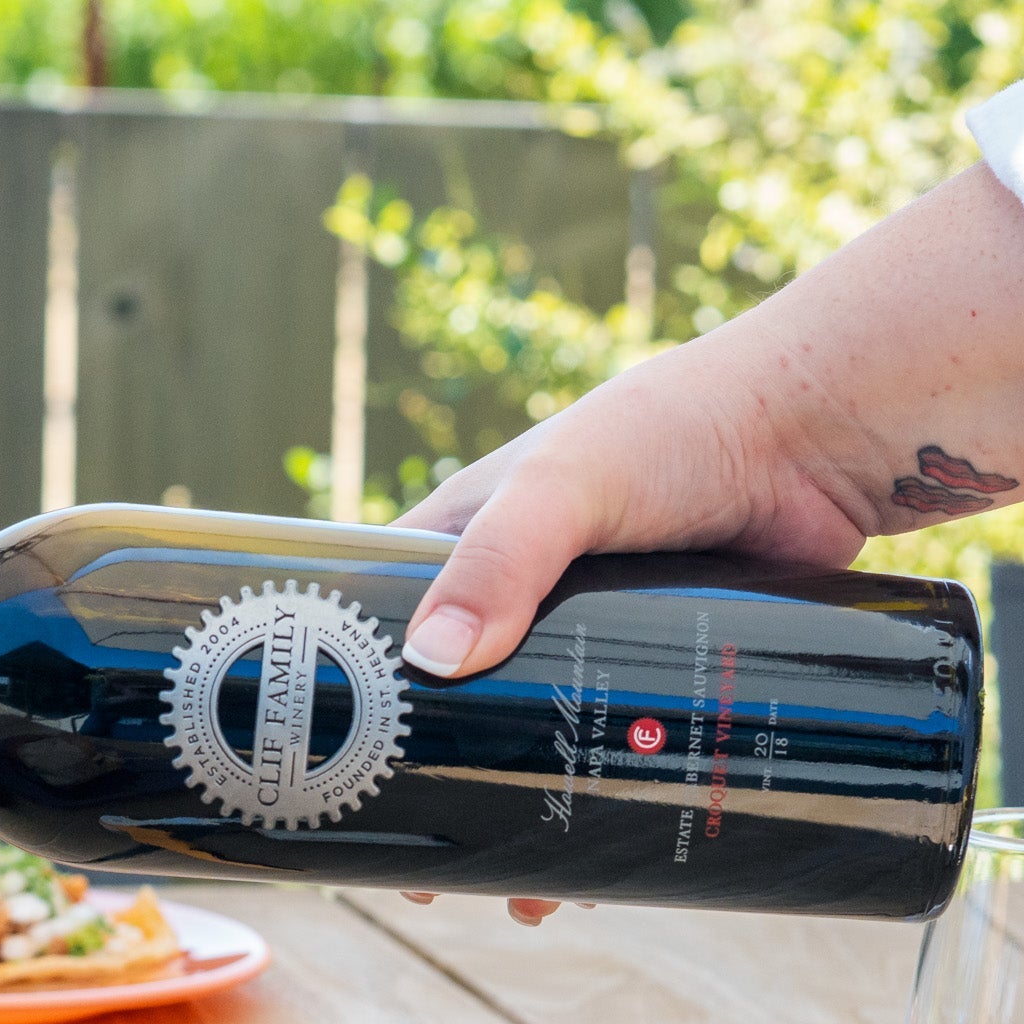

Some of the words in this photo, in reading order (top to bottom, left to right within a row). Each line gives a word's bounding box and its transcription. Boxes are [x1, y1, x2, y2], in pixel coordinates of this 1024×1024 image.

[200, 616, 240, 655] 2004
[265, 604, 296, 727] FAMILY
[341, 620, 386, 680] HELENA
[290, 670, 307, 746] WINERY
[380, 685, 392, 708] ST.
[550, 622, 587, 742] Mountain
[591, 669, 610, 739] VALLEY
[716, 642, 737, 743] VINEYARD
[768, 698, 778, 725] DATE
[182, 661, 227, 786] ESTABLISHED
[378, 716, 391, 734] IN
[674, 809, 694, 863] ESTATE
[693, 611, 709, 708] SAUVIGNON
[754, 733, 768, 757] 20
[774, 737, 788, 755] 18
[257, 736, 284, 806] CLIF
[322, 740, 385, 803] FOUNDED
[541, 730, 577, 833] Howell
[587, 745, 604, 792] NAPA
[705, 749, 729, 838] CROQUET
